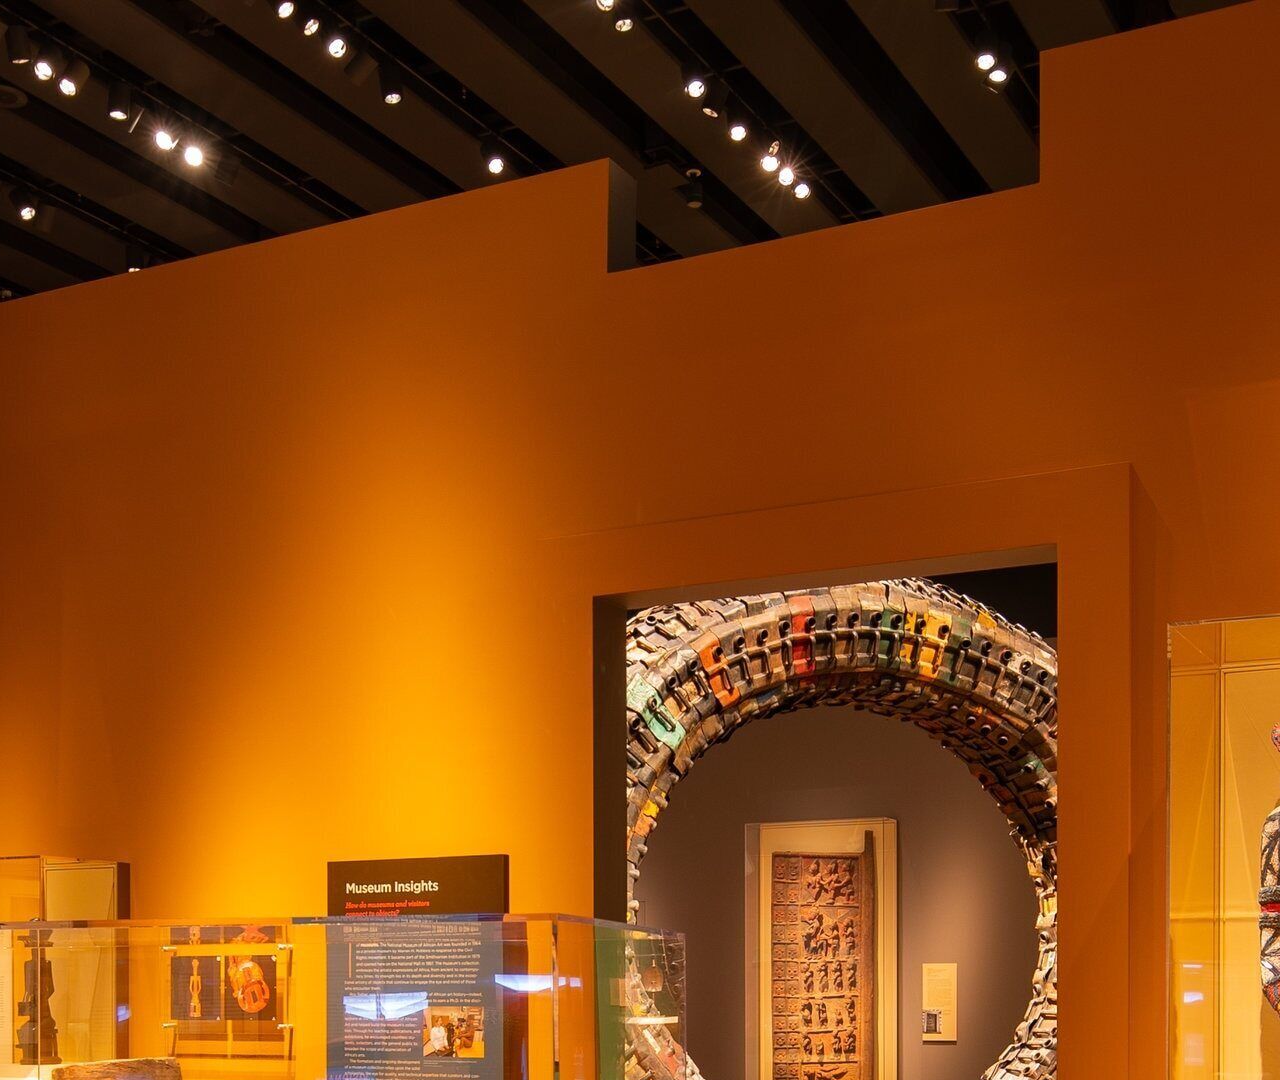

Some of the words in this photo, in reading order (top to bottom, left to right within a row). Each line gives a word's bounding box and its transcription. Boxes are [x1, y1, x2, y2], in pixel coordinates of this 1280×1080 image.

[346, 883, 392, 894] Museum
[394, 880, 439, 894] Insights
[395, 900, 407, 908] and
